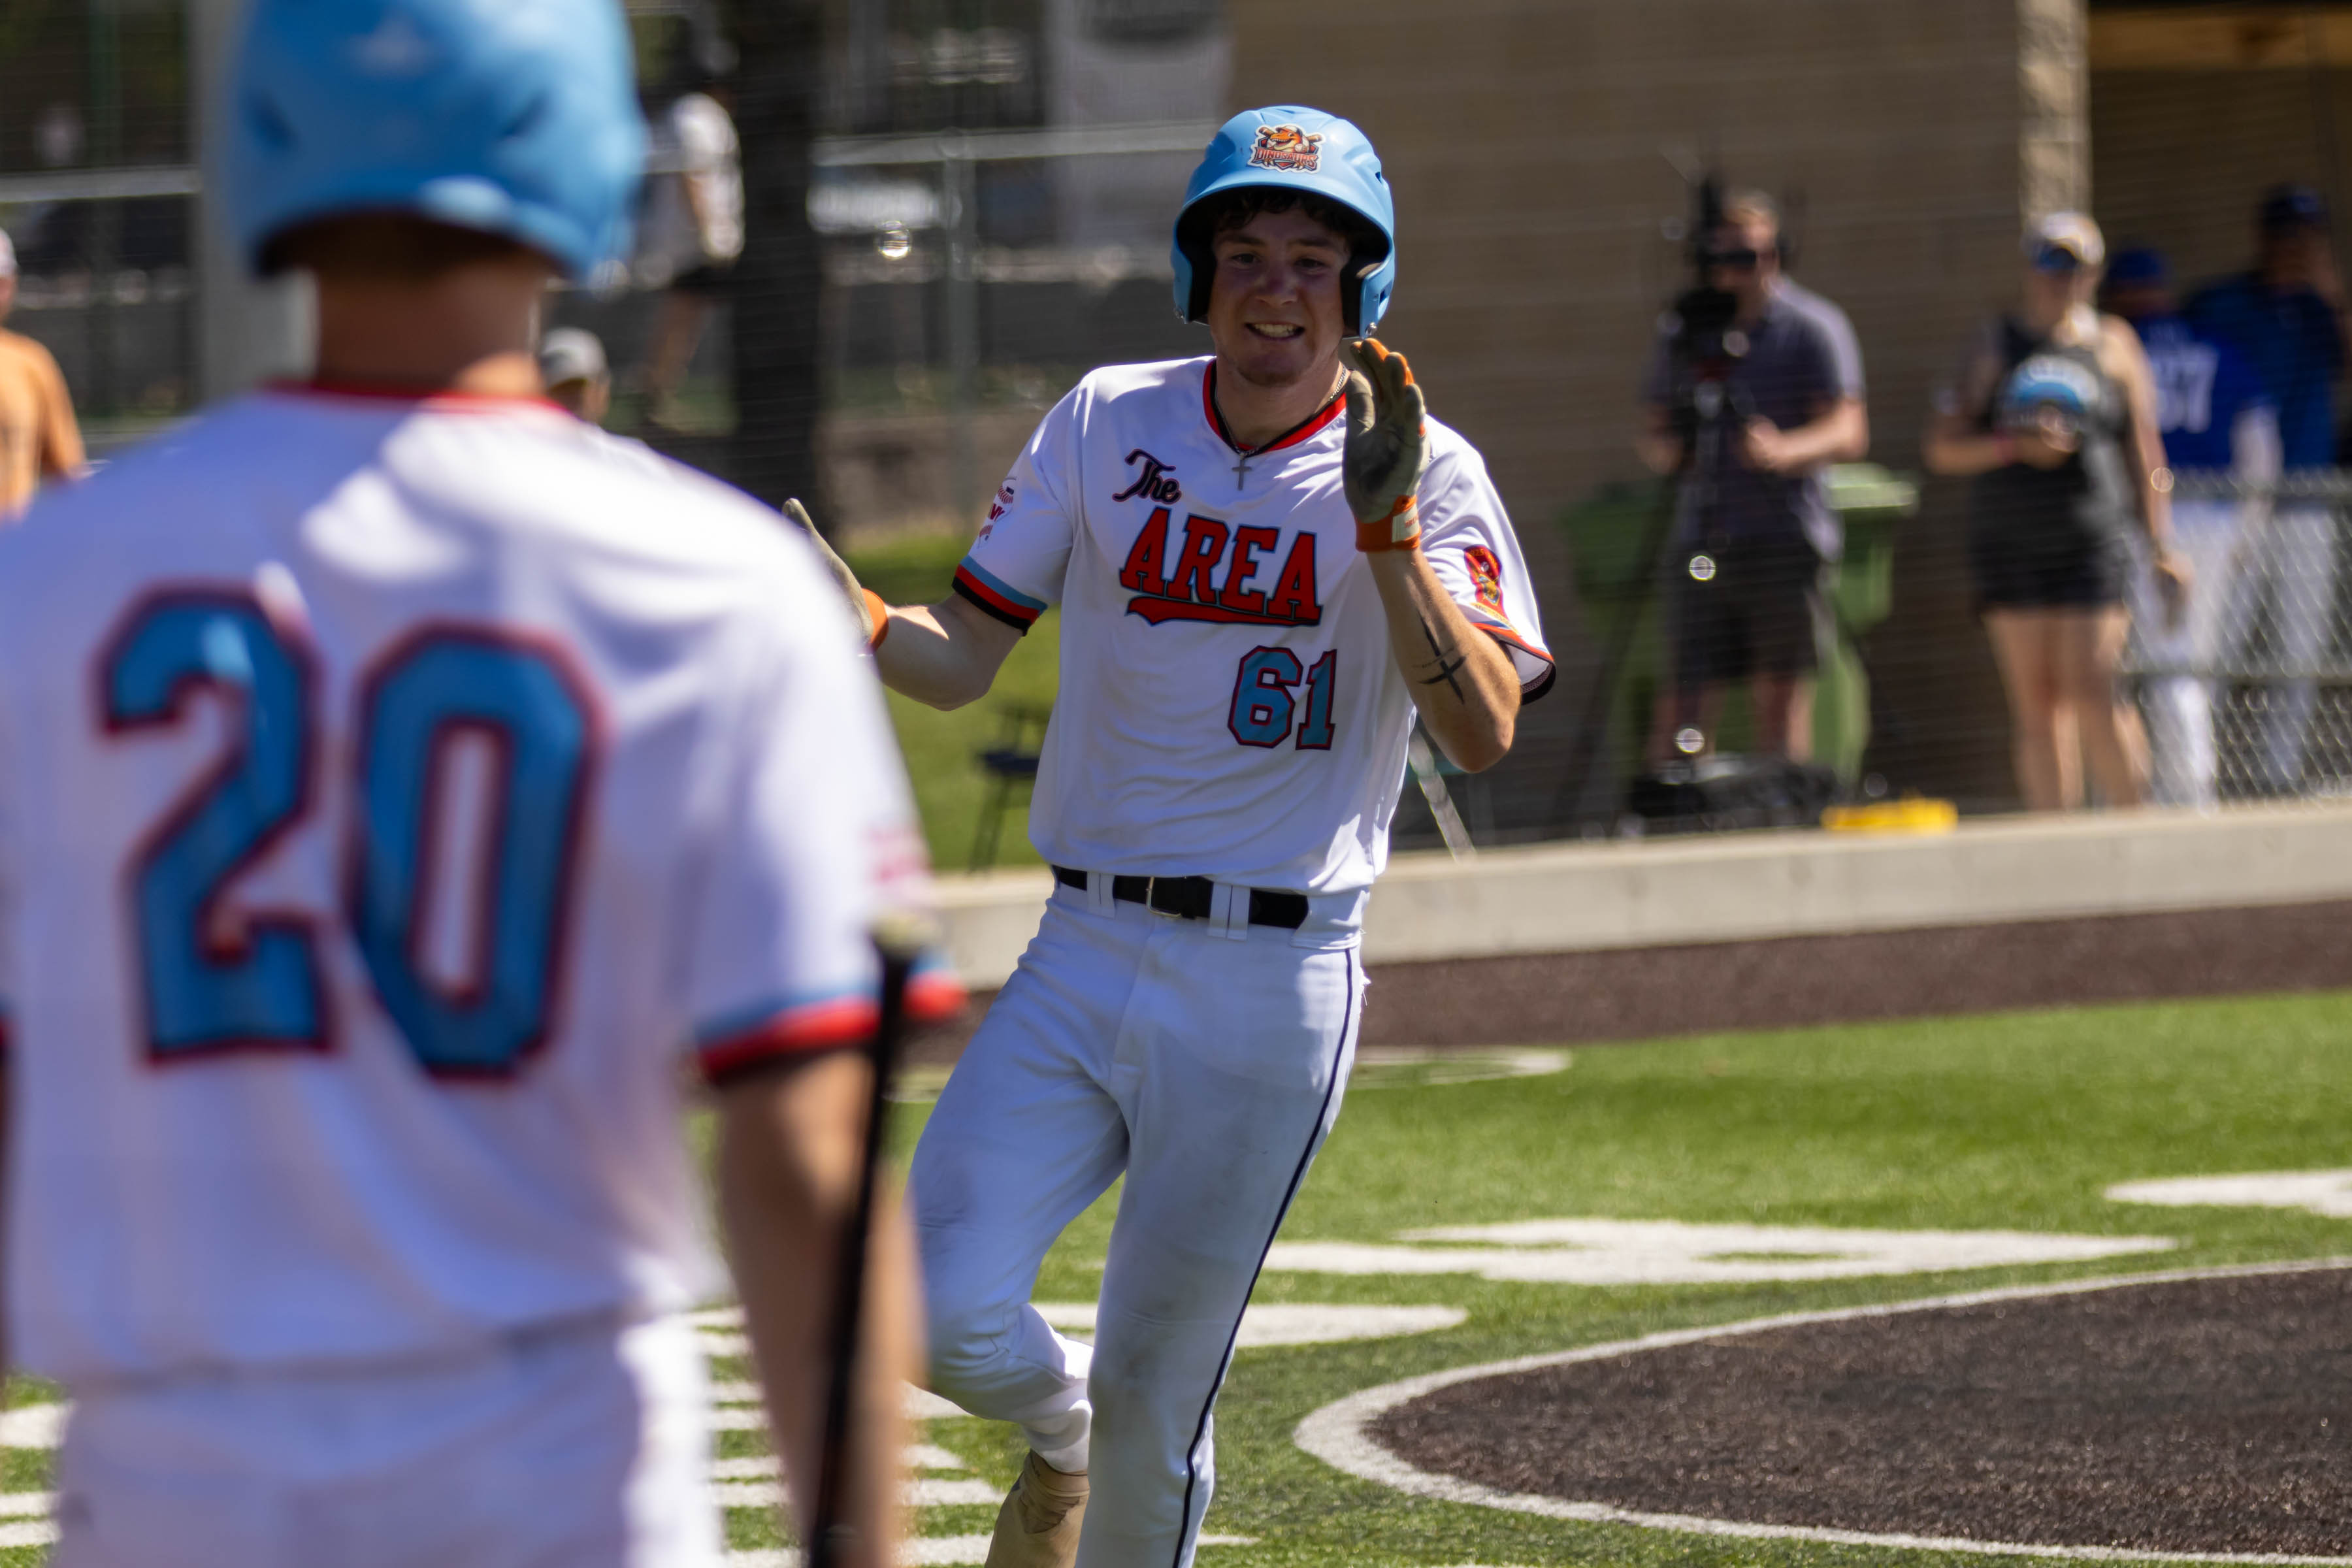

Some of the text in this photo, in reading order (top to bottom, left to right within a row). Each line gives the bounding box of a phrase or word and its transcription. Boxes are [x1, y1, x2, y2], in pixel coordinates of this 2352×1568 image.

[1254, 148, 1317, 169] DINOSAURS
[1113, 448, 1182, 504] The
[1119, 506, 1323, 625] AREA
[1227, 645, 1337, 751] 61
[93, 581, 610, 1082] 20
